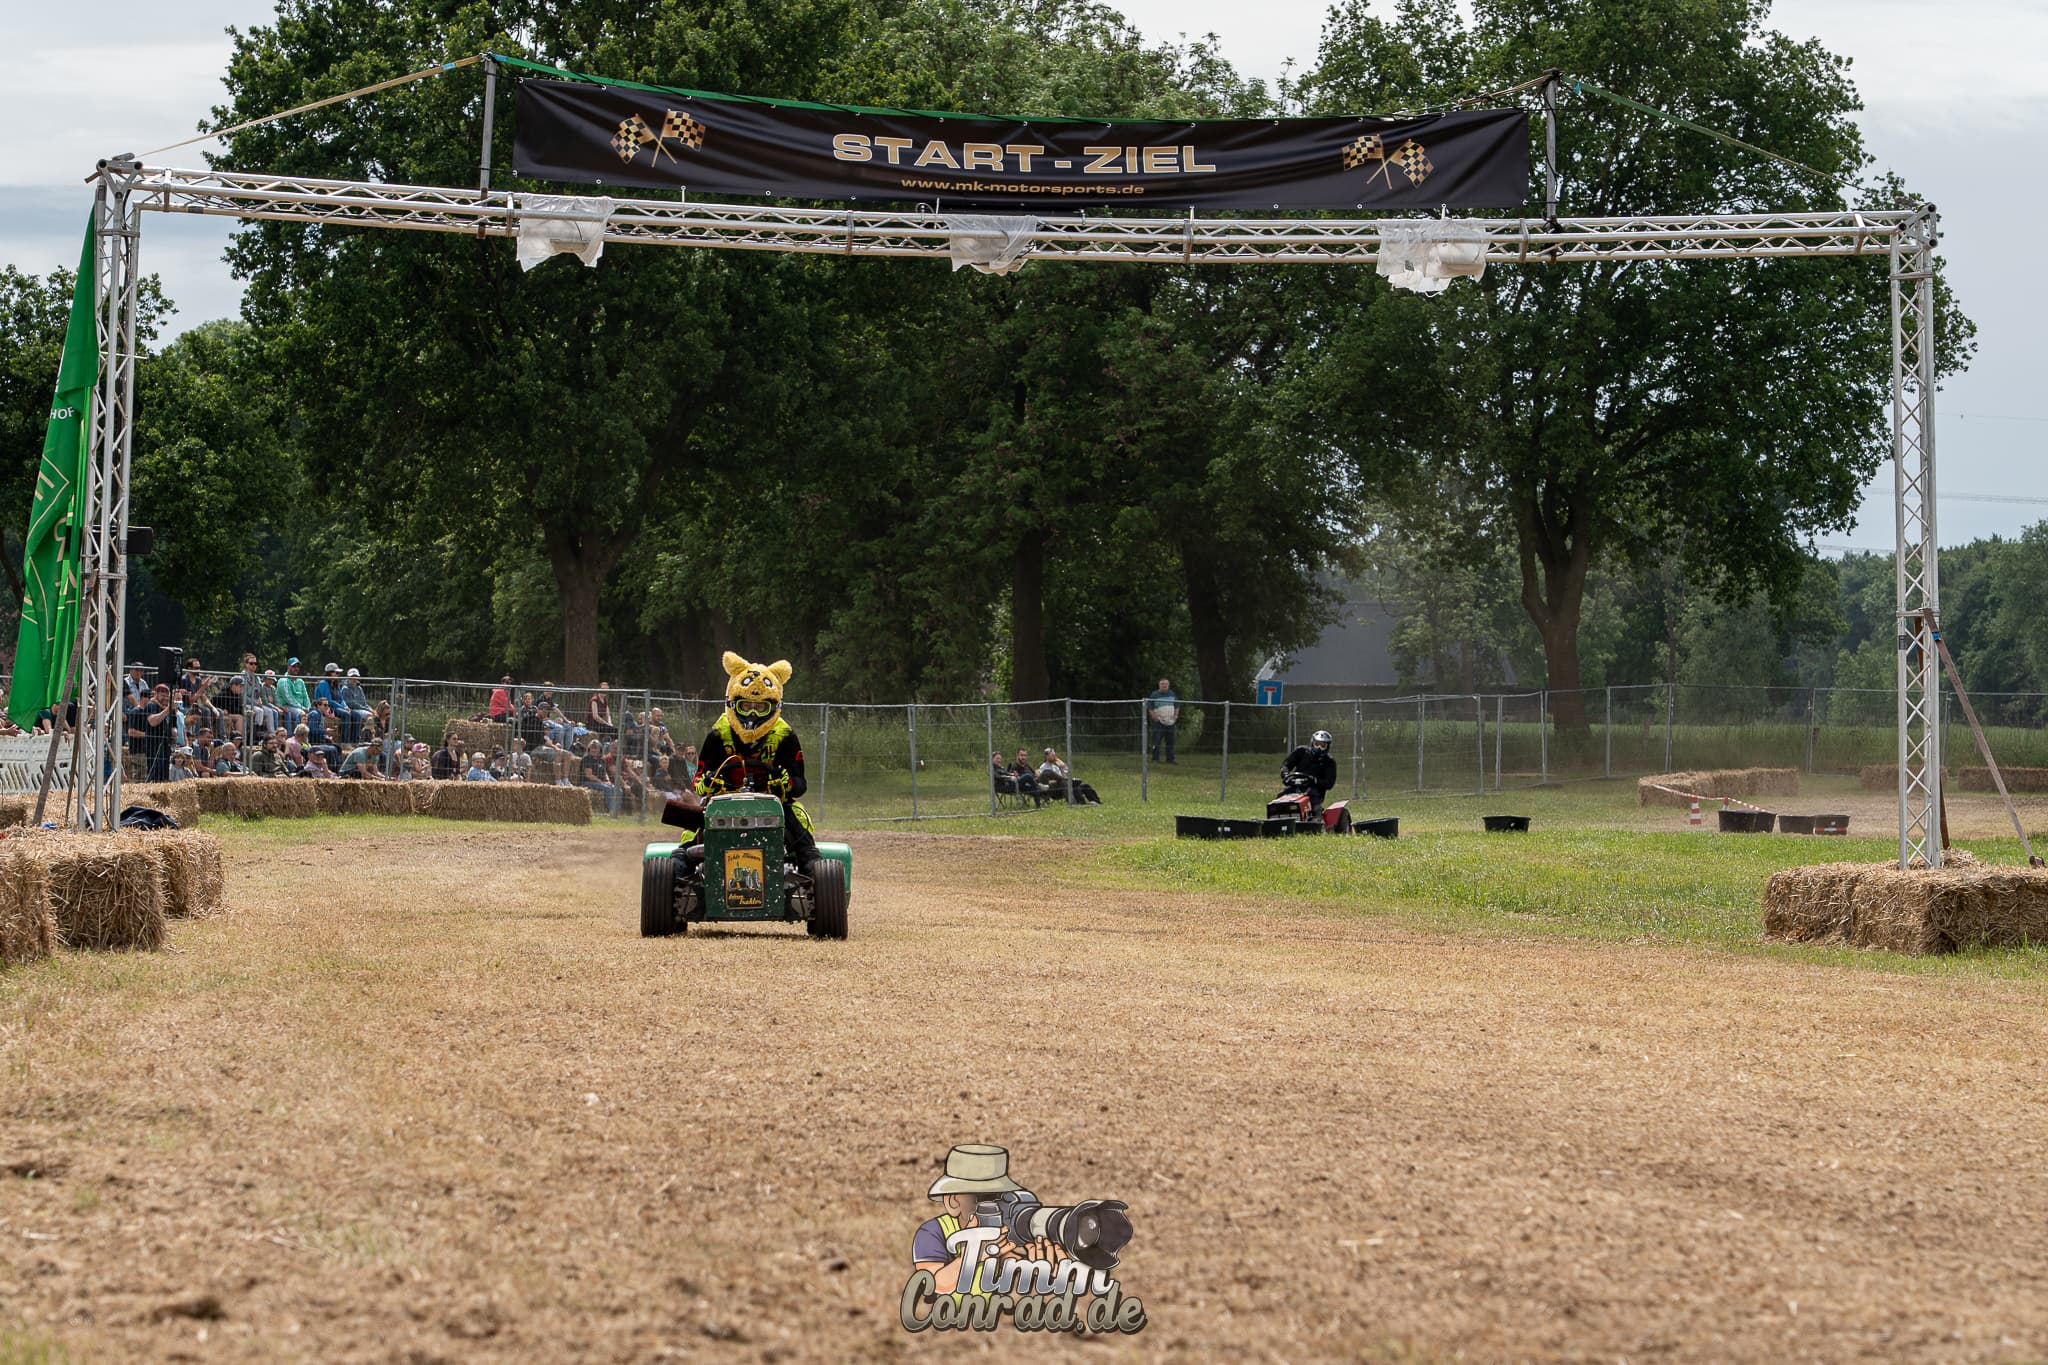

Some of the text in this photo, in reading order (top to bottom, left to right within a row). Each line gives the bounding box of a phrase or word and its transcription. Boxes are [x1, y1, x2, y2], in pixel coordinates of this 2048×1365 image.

[832, 133, 1045, 173] START
[1083, 145, 1217, 174] ZIEL
[901, 178, 1145, 196] www.mk-motorsports.de
